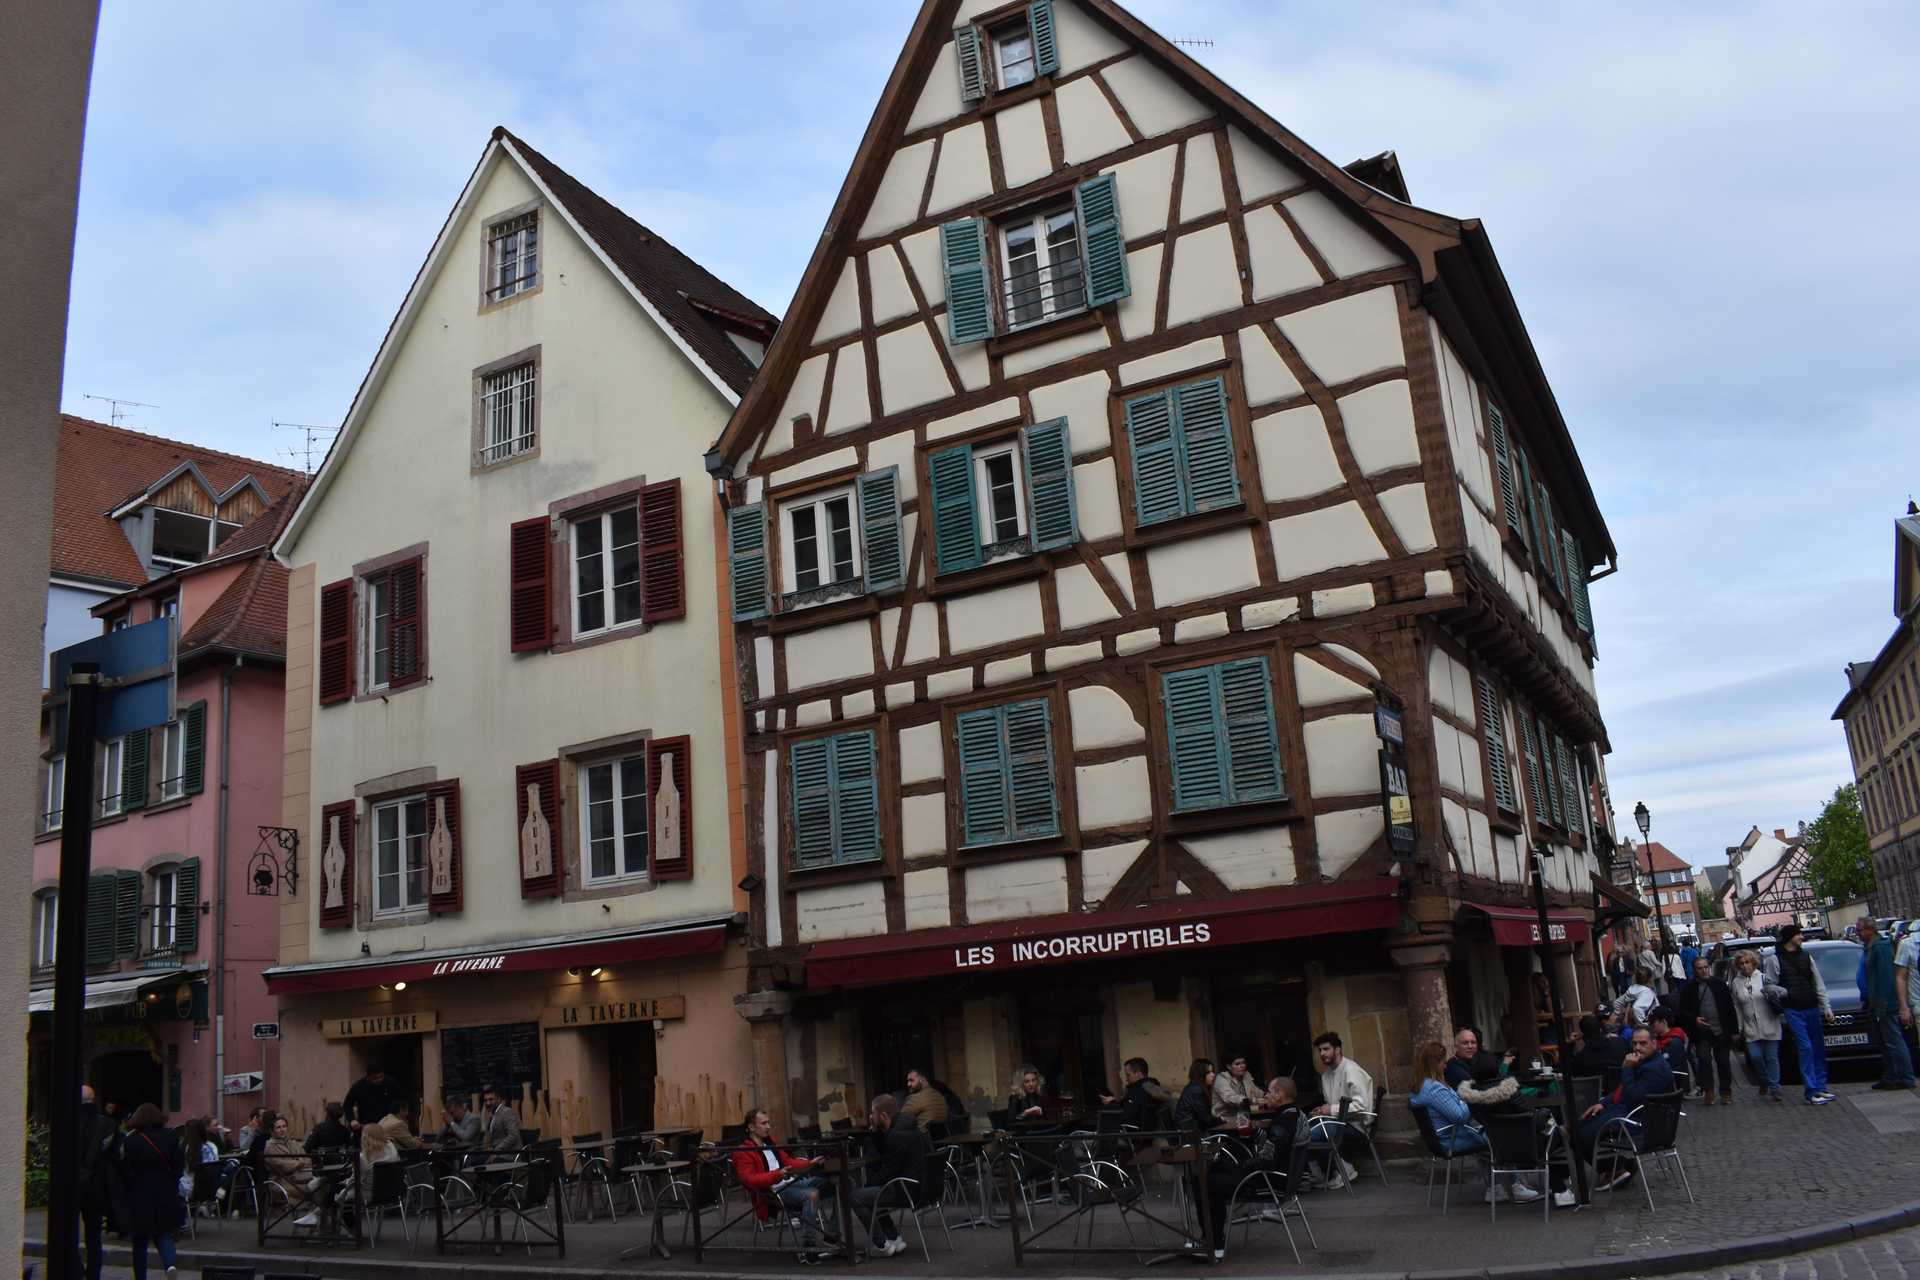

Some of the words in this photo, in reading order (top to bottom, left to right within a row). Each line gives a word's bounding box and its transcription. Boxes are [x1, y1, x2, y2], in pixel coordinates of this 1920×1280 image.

[1386, 762, 1409, 796] BAR
[955, 946, 994, 967] LES
[1012, 923, 1211, 962] INCORRUPTIBLES
[433, 962, 447, 975] LA
[450, 956, 506, 973] TAVERNE
[563, 1007, 578, 1023] LA
[590, 1000, 659, 1021] TAVERNE
[340, 1021, 352, 1034] LA
[362, 1014, 418, 1032] TAVERNE
